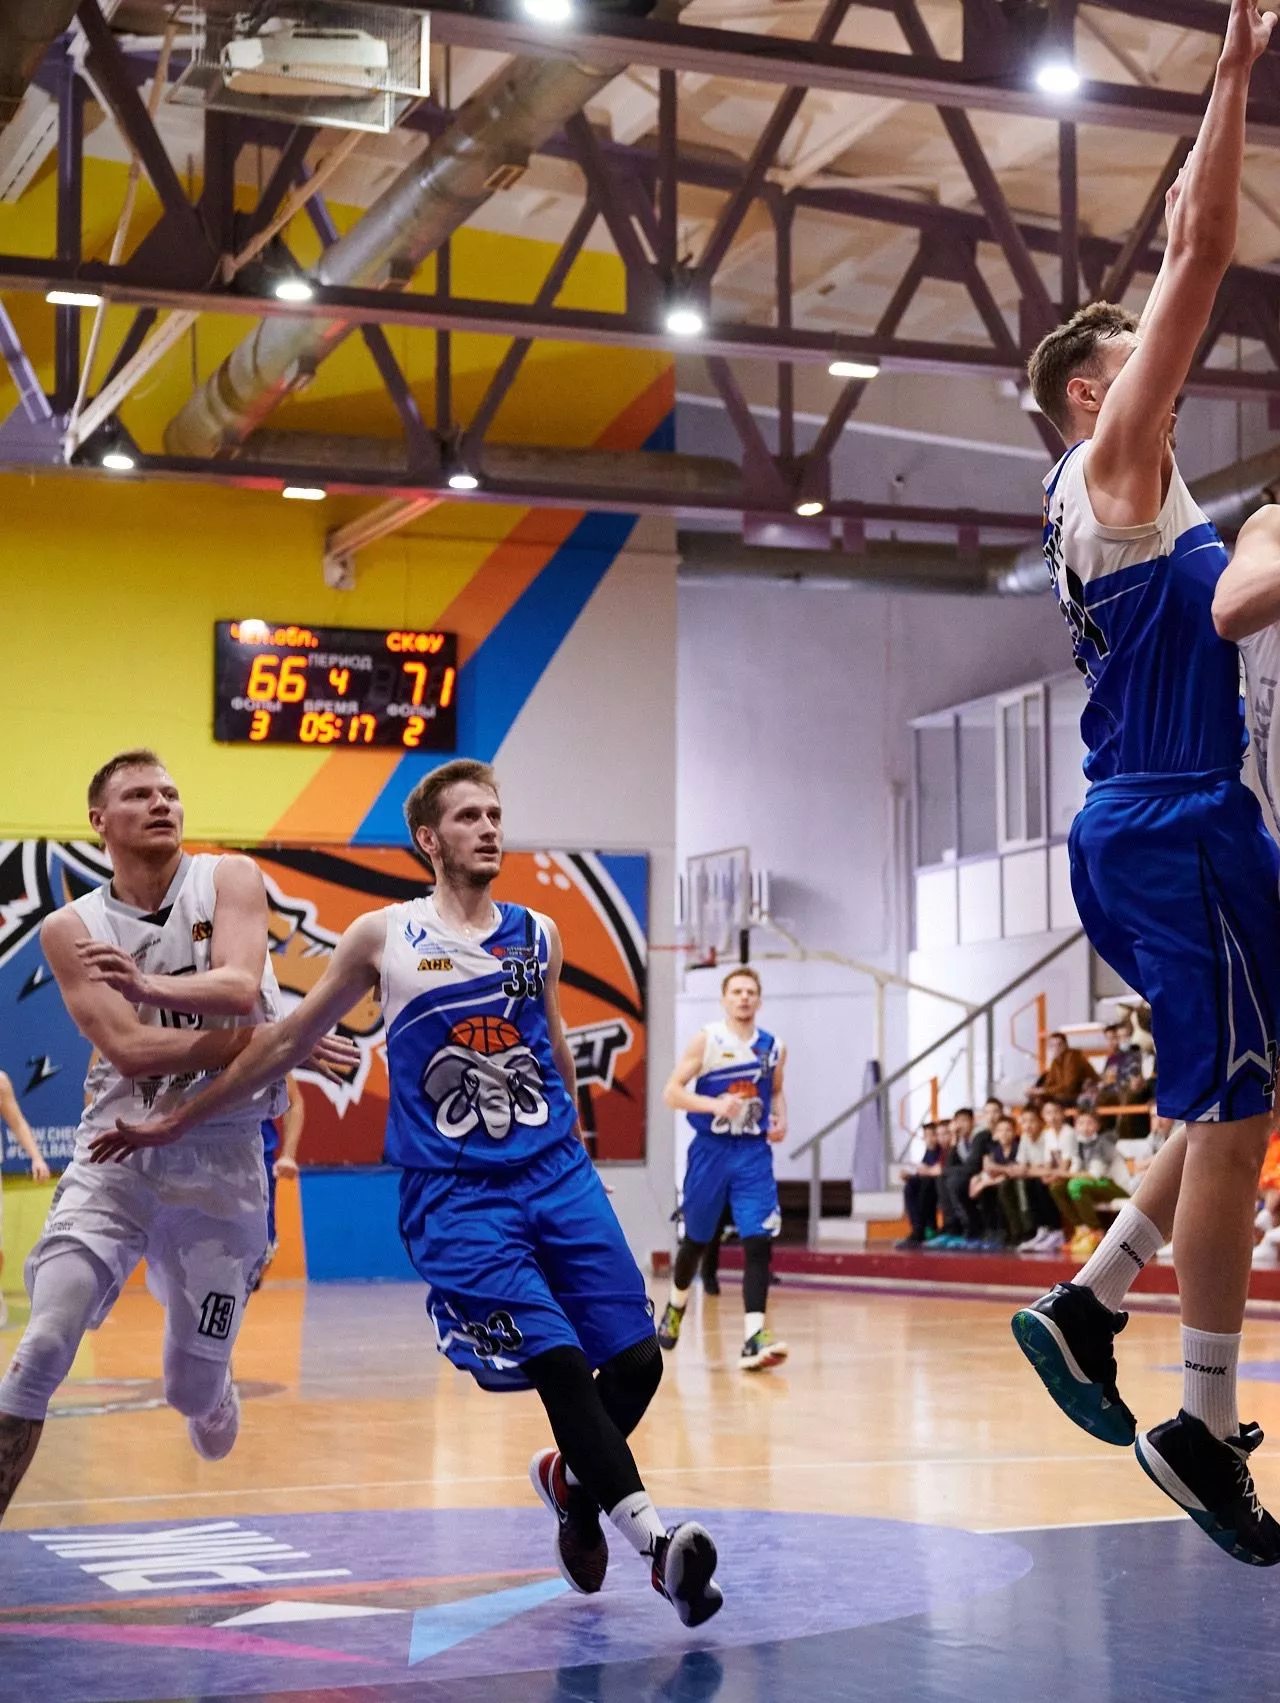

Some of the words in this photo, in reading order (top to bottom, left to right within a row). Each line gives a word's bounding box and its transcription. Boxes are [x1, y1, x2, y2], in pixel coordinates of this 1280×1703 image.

[308, 653, 373, 671] ПЕРИОД
[247, 654, 308, 703] 66
[328, 668, 350, 695] 4
[403, 661, 455, 707] 71
[231, 697, 282, 712] ФОЛЫ
[303, 699, 359, 714] ВРЕМЯ
[386, 704, 437, 719] ФОЛЫ
[249, 710, 271, 741] 3
[299, 712, 376, 743] 05:17
[402, 715, 425, 747] 2
[502, 957, 545, 1000] 33
[198, 1291, 236, 1341] 13
[1185, 1360, 1227, 1375] DEMIX
